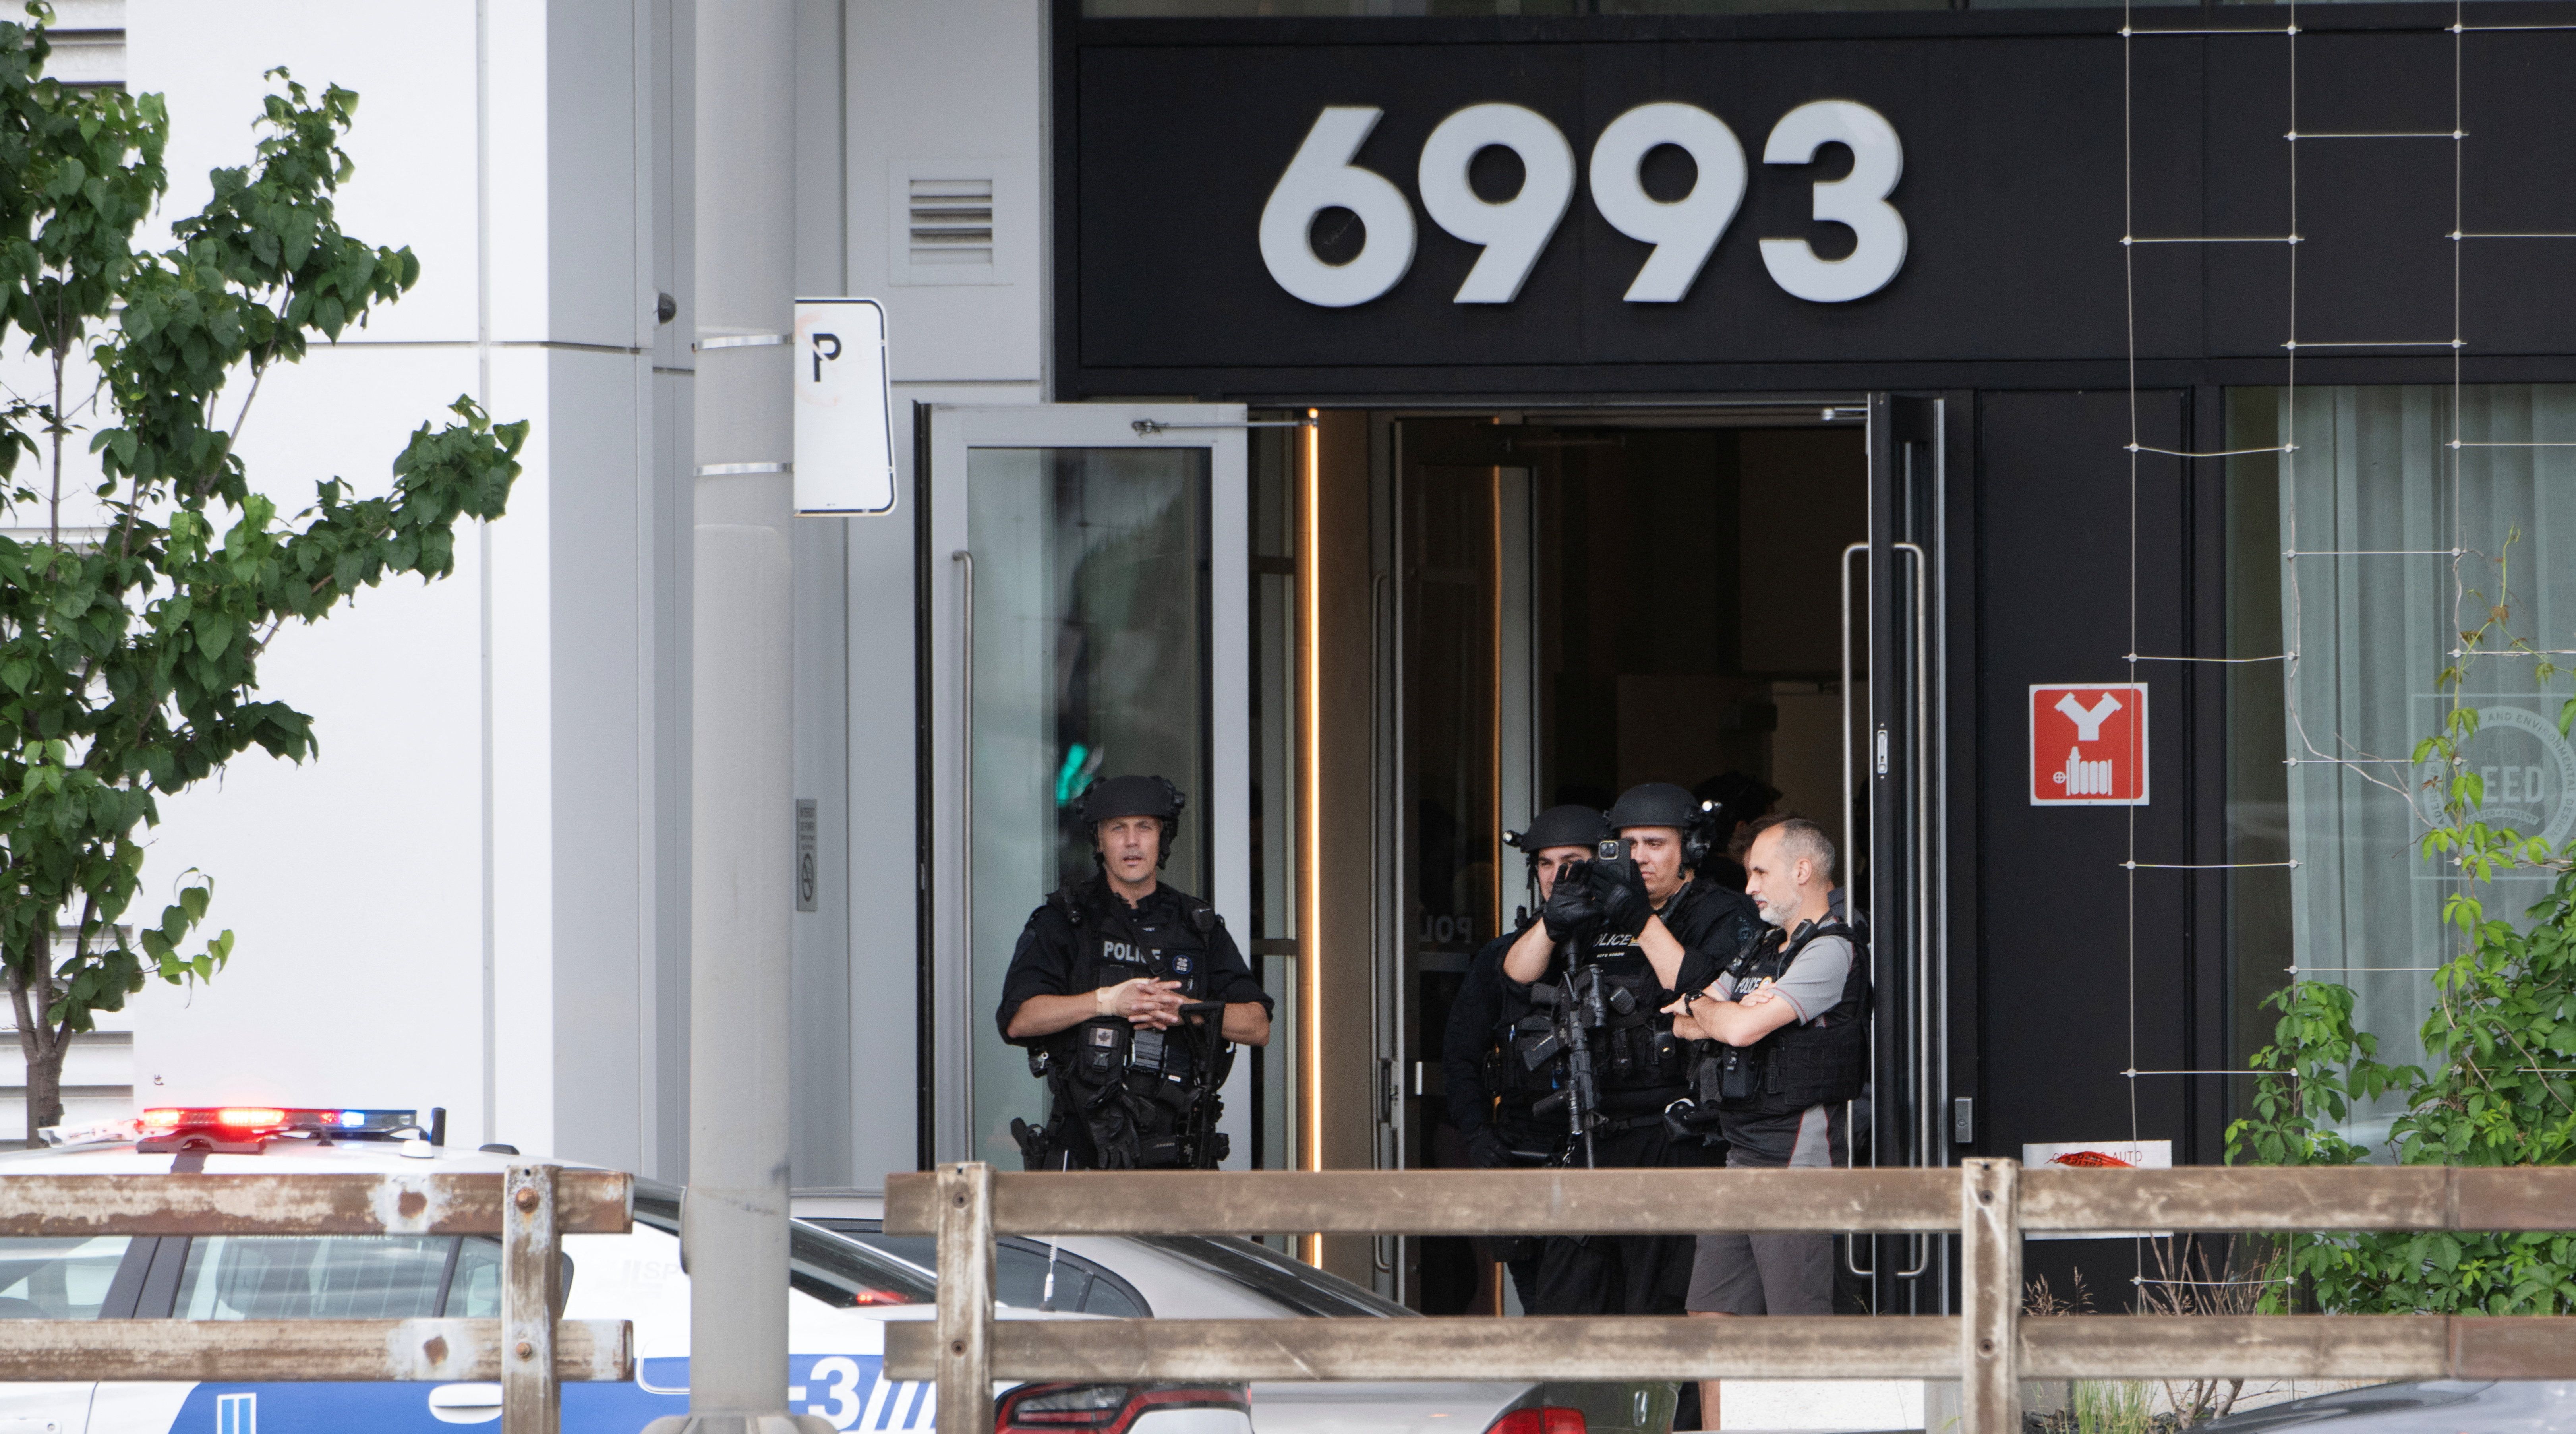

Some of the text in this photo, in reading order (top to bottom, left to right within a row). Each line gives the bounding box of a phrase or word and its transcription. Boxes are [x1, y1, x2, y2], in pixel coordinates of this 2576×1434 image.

[1259, 101, 1908, 308] 6993
[812, 333, 842, 382] P
[2487, 712, 2512, 722] AND
[1593, 933, 1632, 947] OLICE
